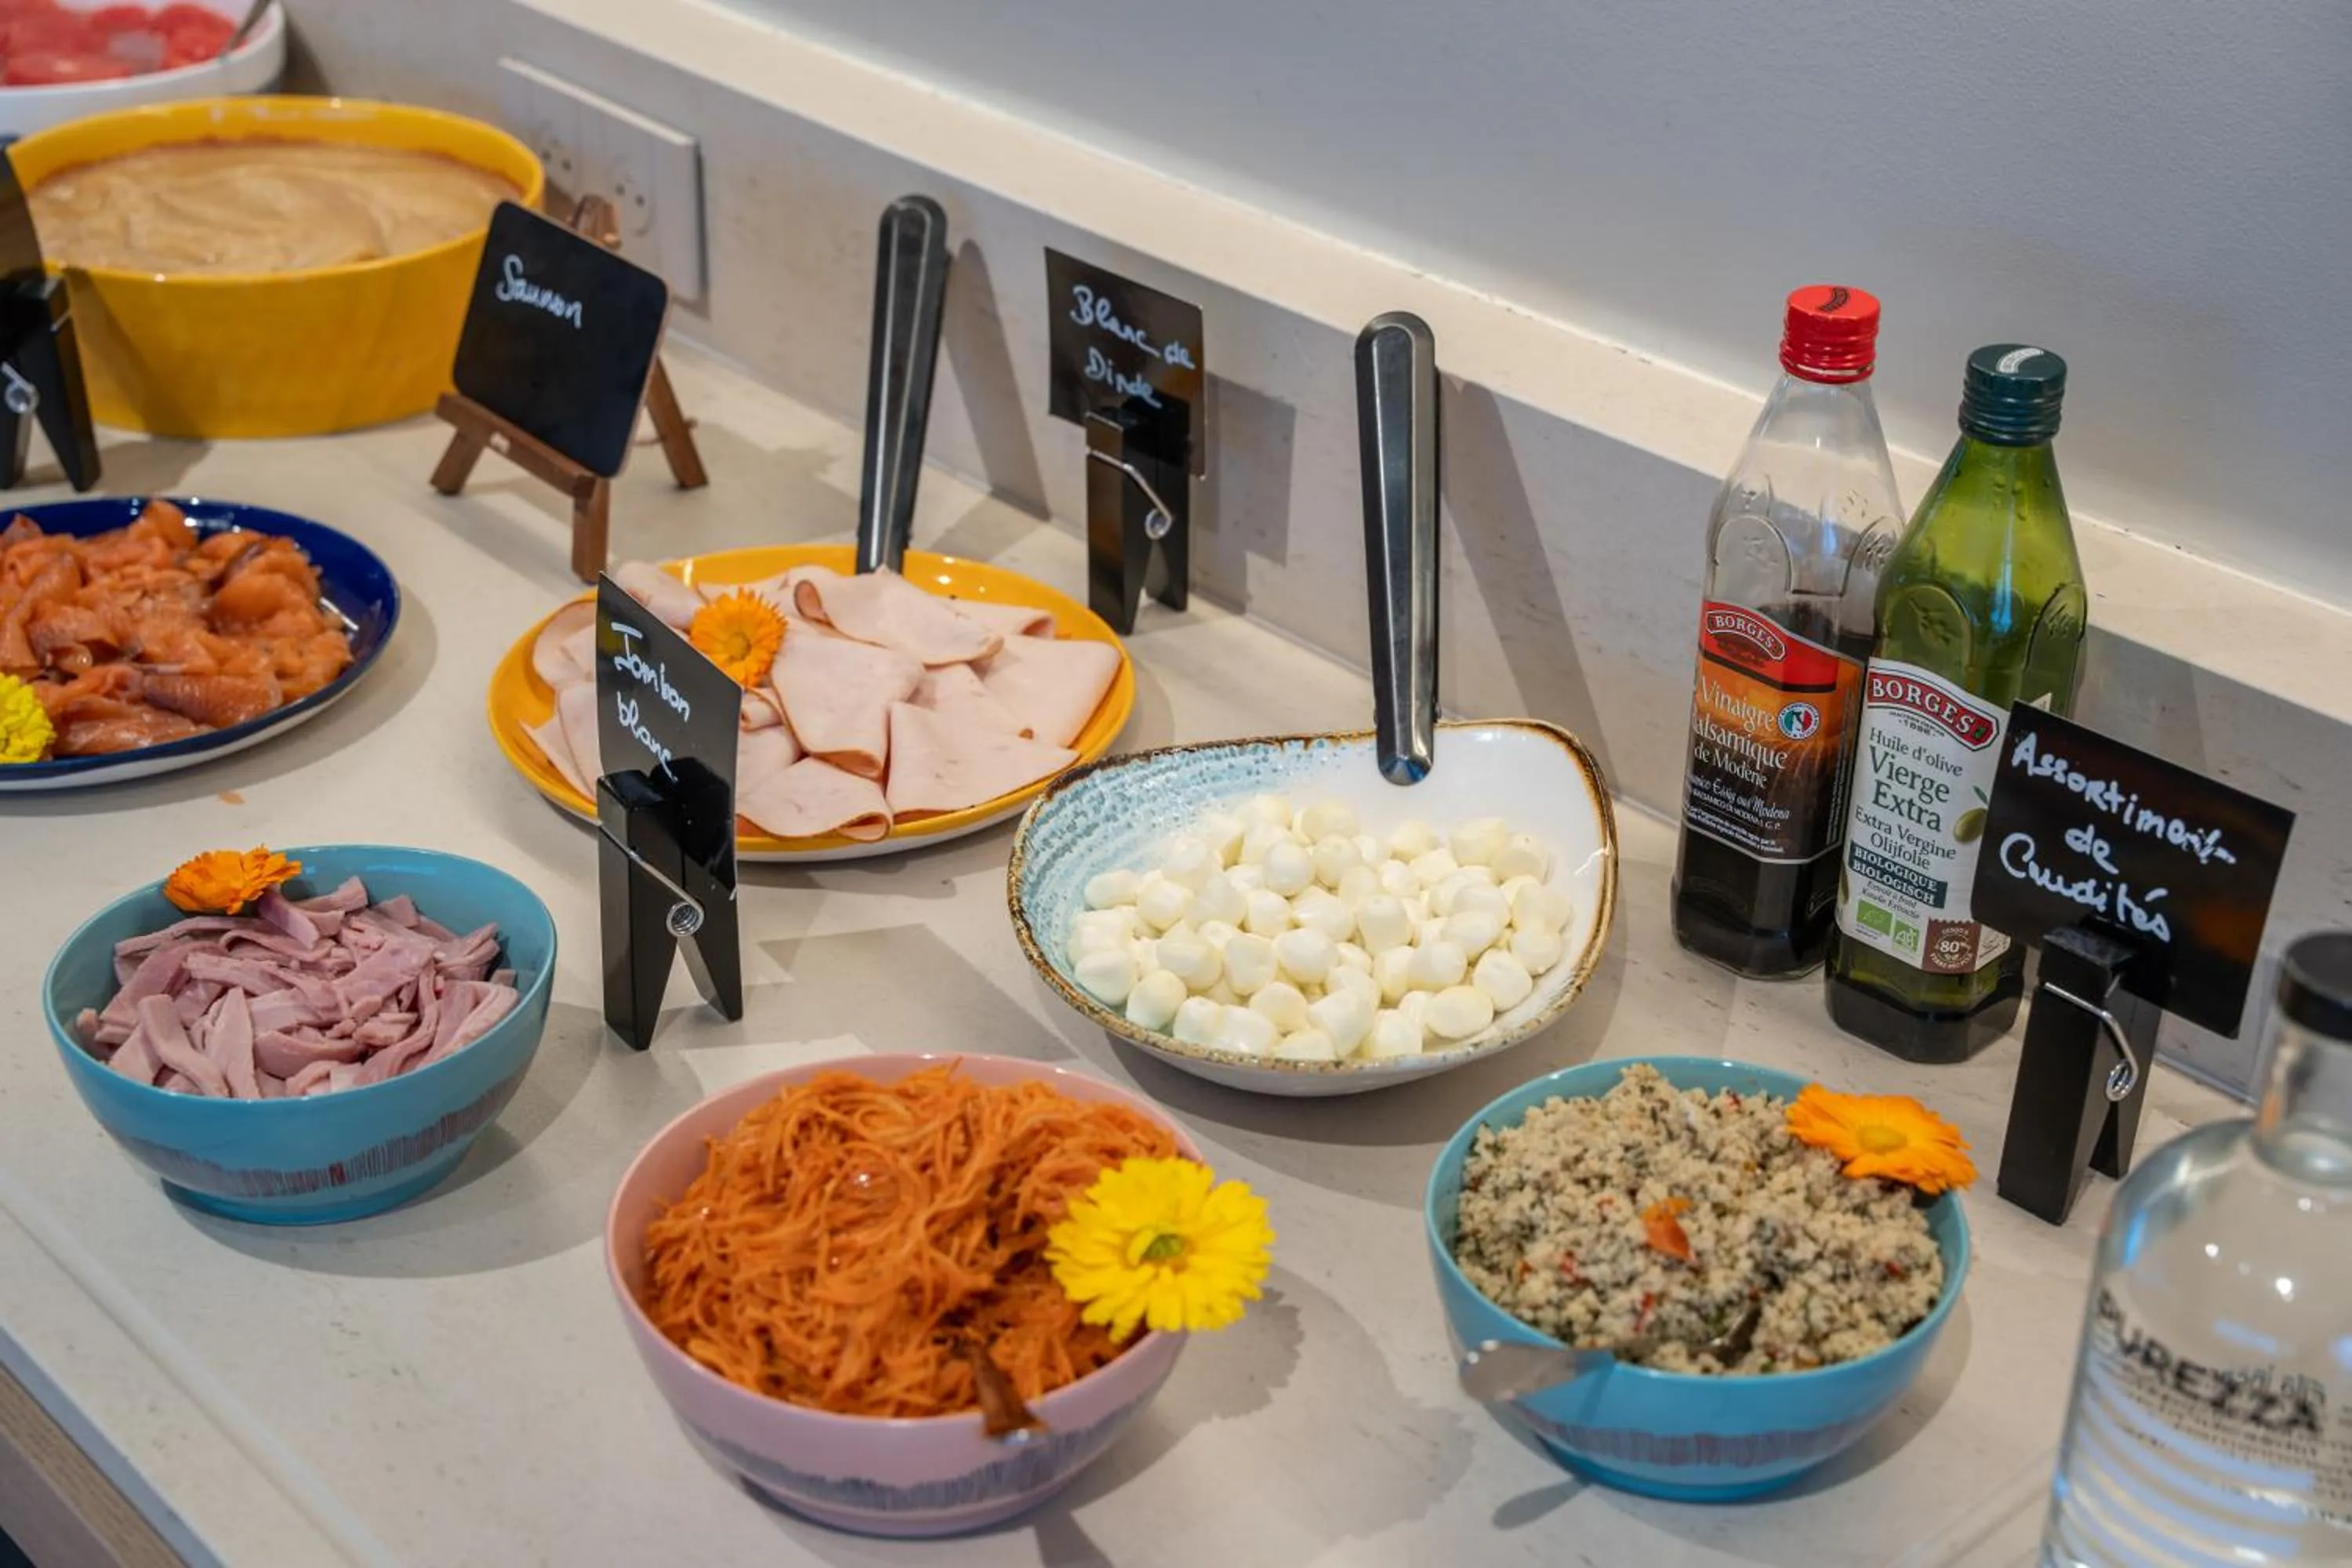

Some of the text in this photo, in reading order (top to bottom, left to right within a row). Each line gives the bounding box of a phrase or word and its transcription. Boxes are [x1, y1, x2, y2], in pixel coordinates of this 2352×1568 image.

[1070, 284, 1196, 370] Blanc de
[1083, 346, 1163, 409] Dinde
[1715, 615, 1776, 649] BORGES
[1701, 675, 1776, 733] Vinaigre
[1871, 677, 1975, 734] BORGES
[1693, 741, 1711, 763] de
[1869, 726, 1963, 777] Huile d'olive
[1869, 745, 1951, 805] Vierge
[1855, 804, 1957, 860] Extra Vergine
[1872, 779, 1941, 833] Extra
[1854, 847, 1938, 891] BIOLOGIQUE
[1870, 832, 1932, 870] Olijfolie
[2063, 823, 2119, 875] de
[1853, 860, 1936, 906] BIOLOGISCH
